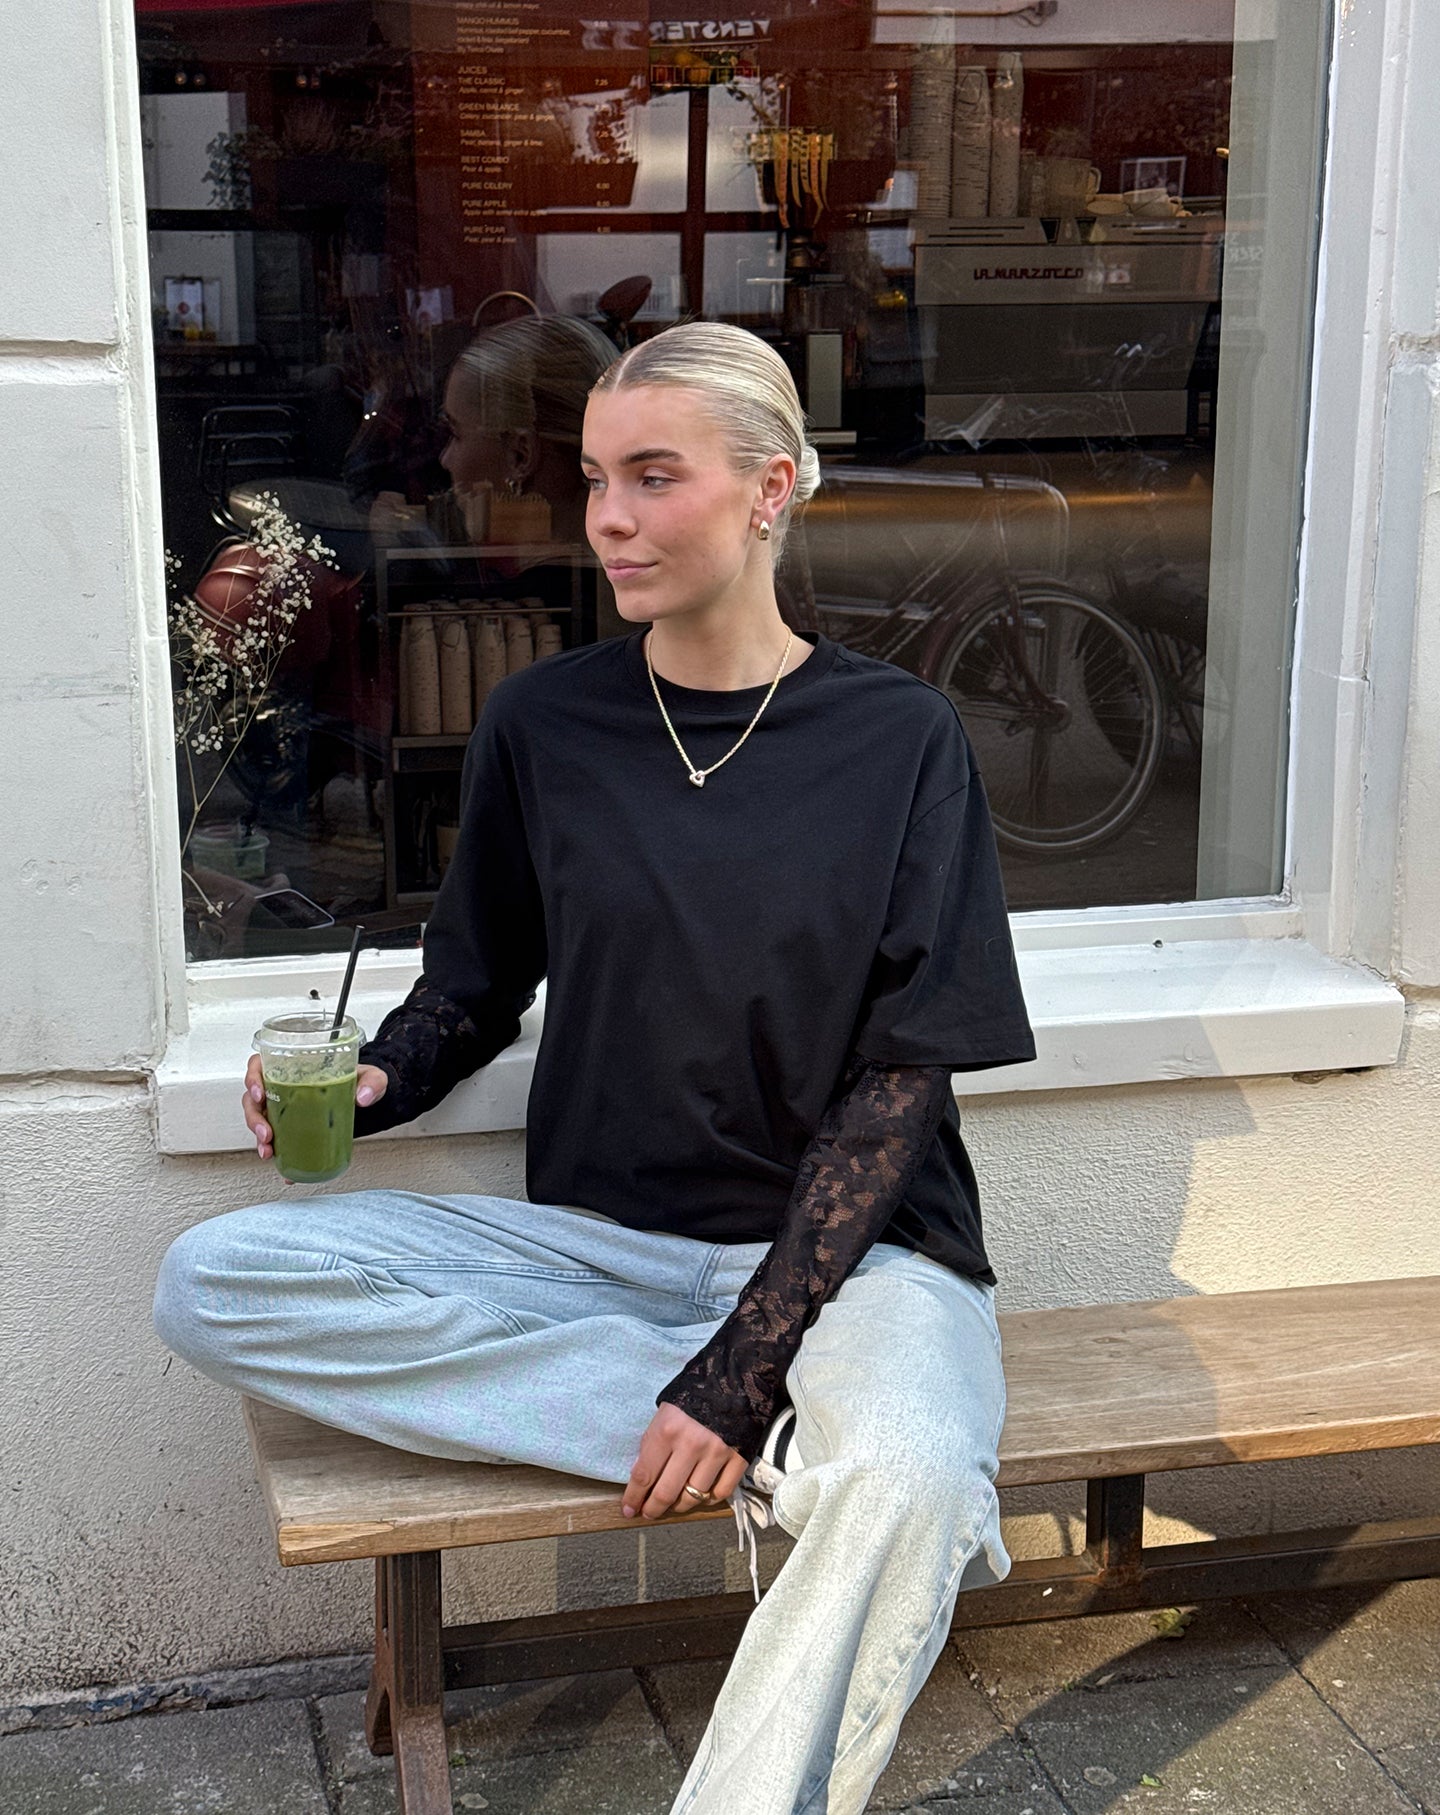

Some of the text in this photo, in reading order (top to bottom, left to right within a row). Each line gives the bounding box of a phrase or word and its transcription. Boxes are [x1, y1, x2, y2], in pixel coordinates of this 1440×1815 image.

[462, 181, 482, 190] PURE
[462, 200, 483, 208] PURE
[973, 268, 988, 280] LA
